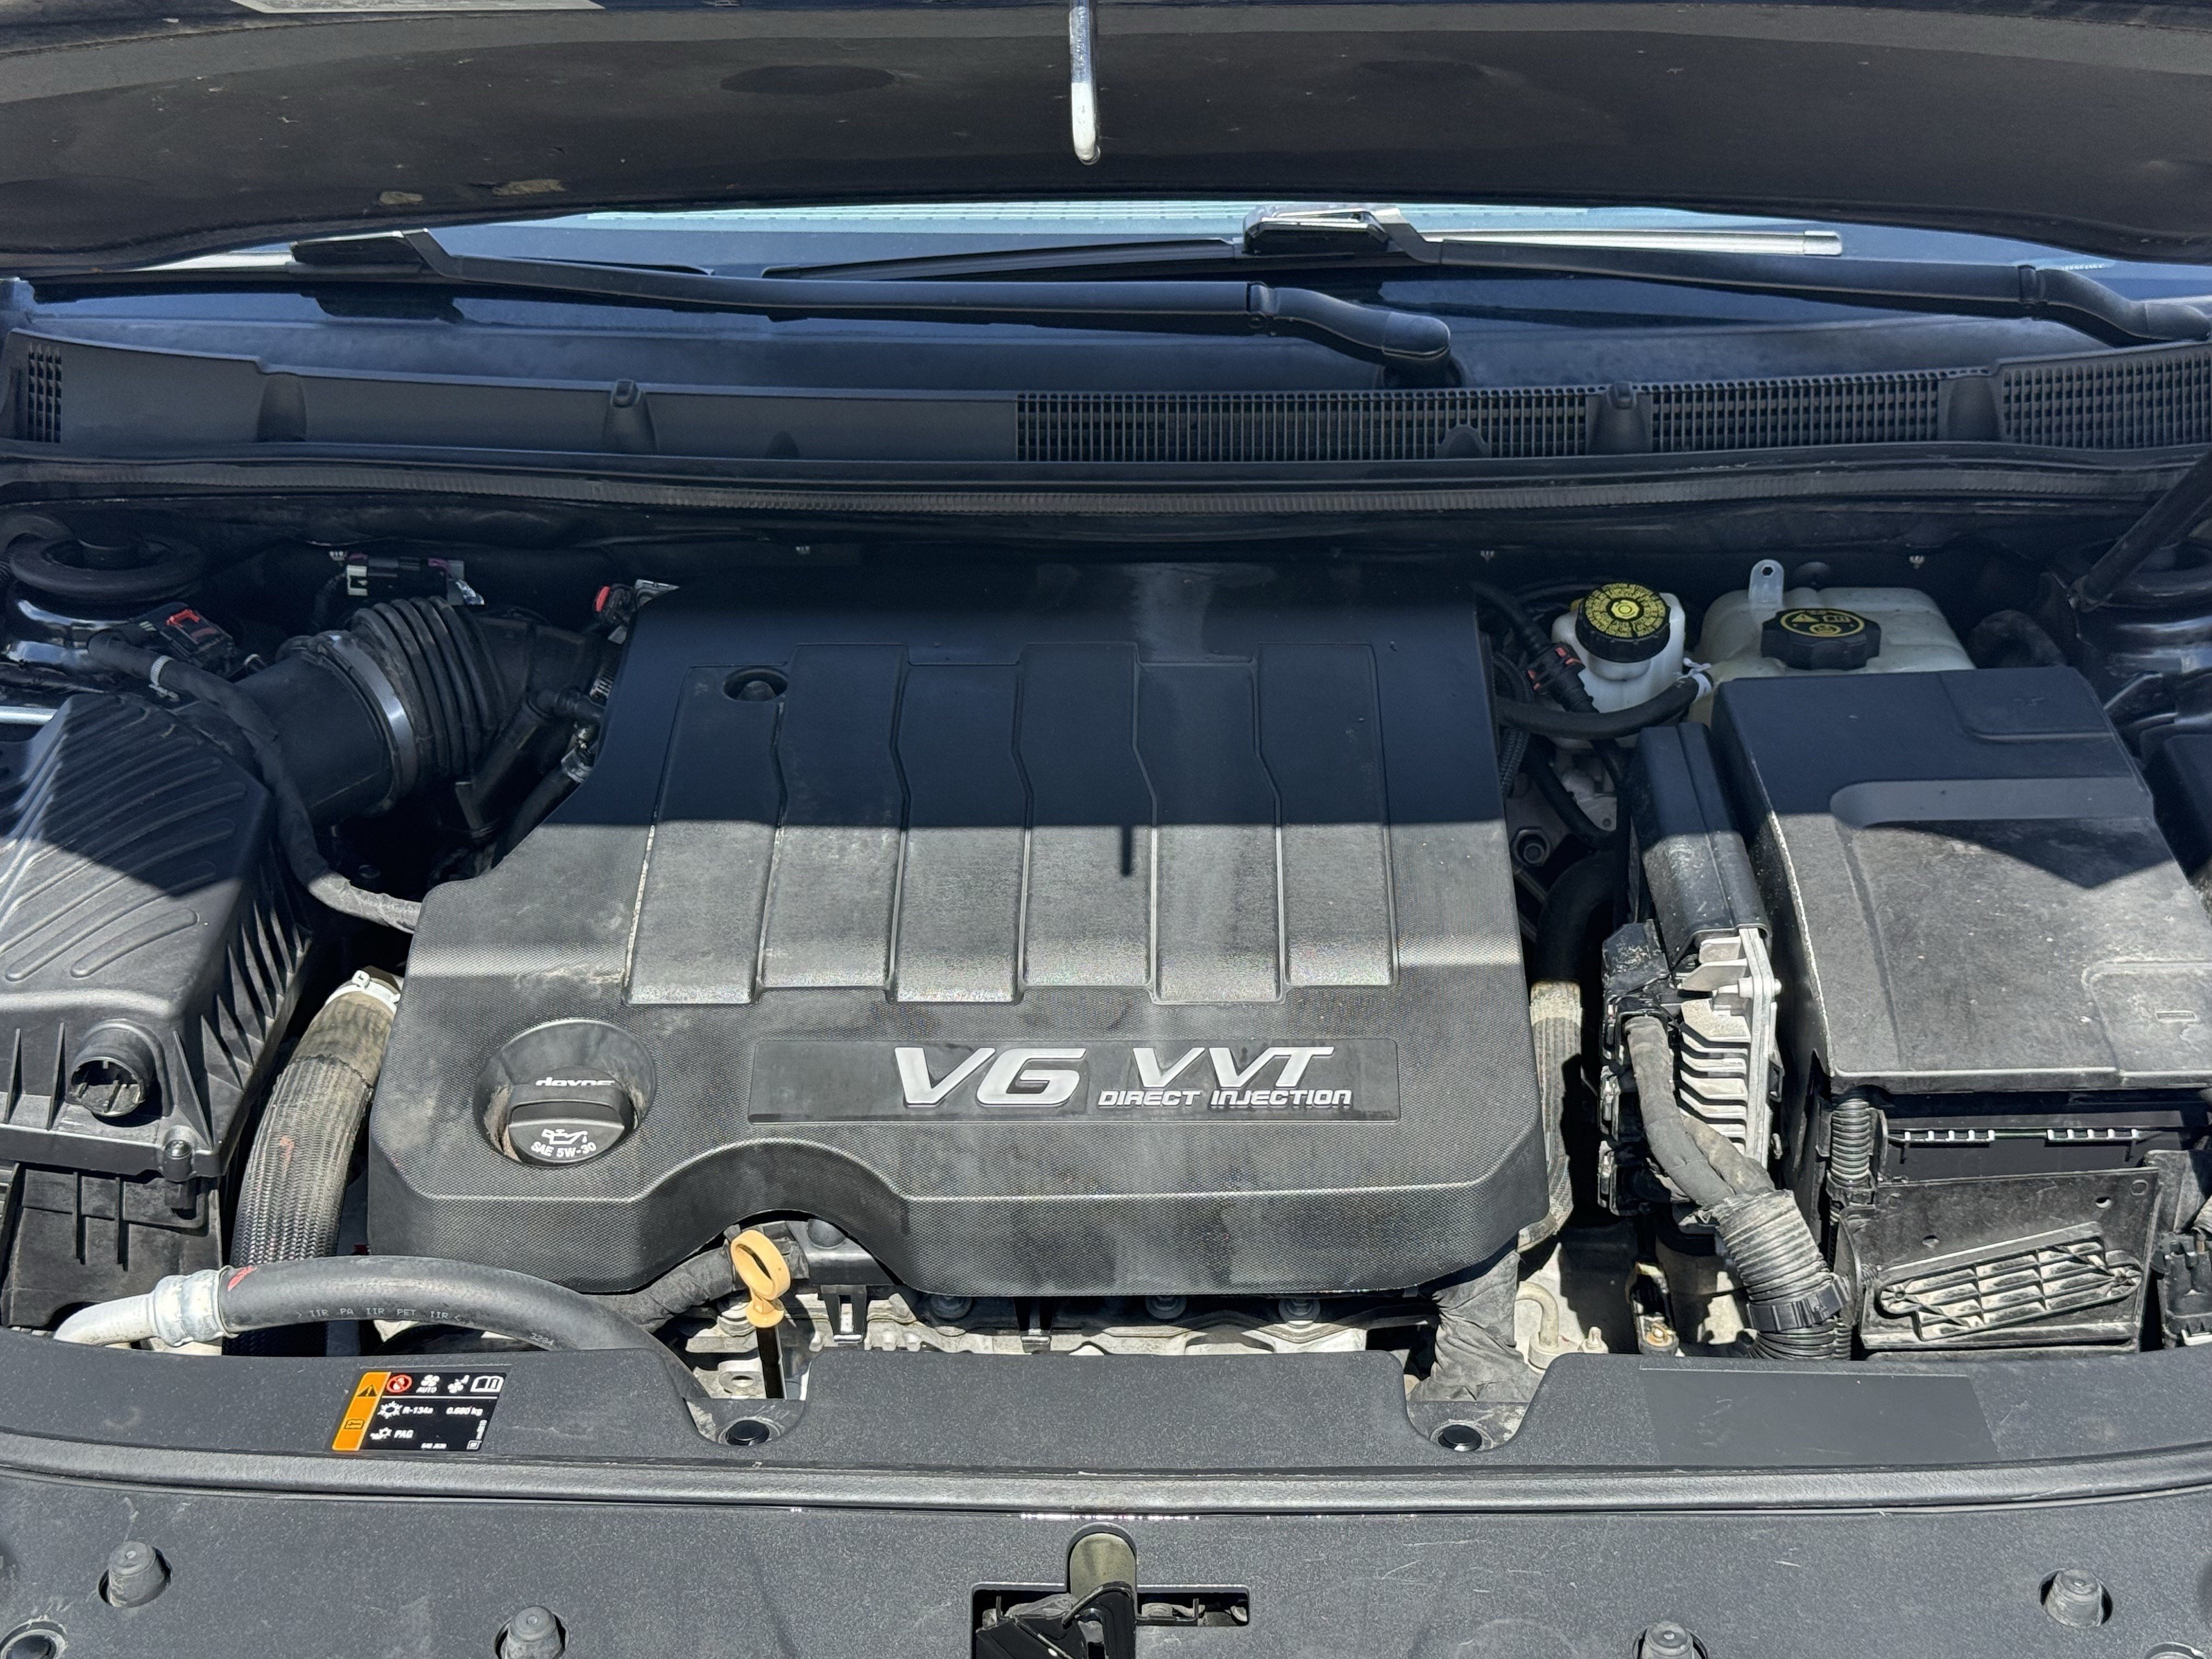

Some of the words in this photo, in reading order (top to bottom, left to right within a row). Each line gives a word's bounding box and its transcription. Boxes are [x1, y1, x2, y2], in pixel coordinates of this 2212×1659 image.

[894, 1047, 1087, 1109] V6
[1132, 1046, 1335, 1088] VVT
[1098, 1090, 1201, 1107] DIRECT
[1210, 1089, 1352, 1107] INJECTION
[531, 1142, 555, 1157] SAE
[556, 1142, 597, 1158] 5W-30
[397, 1308, 417, 1316] PET
[393, 1429, 414, 1439] PAG
